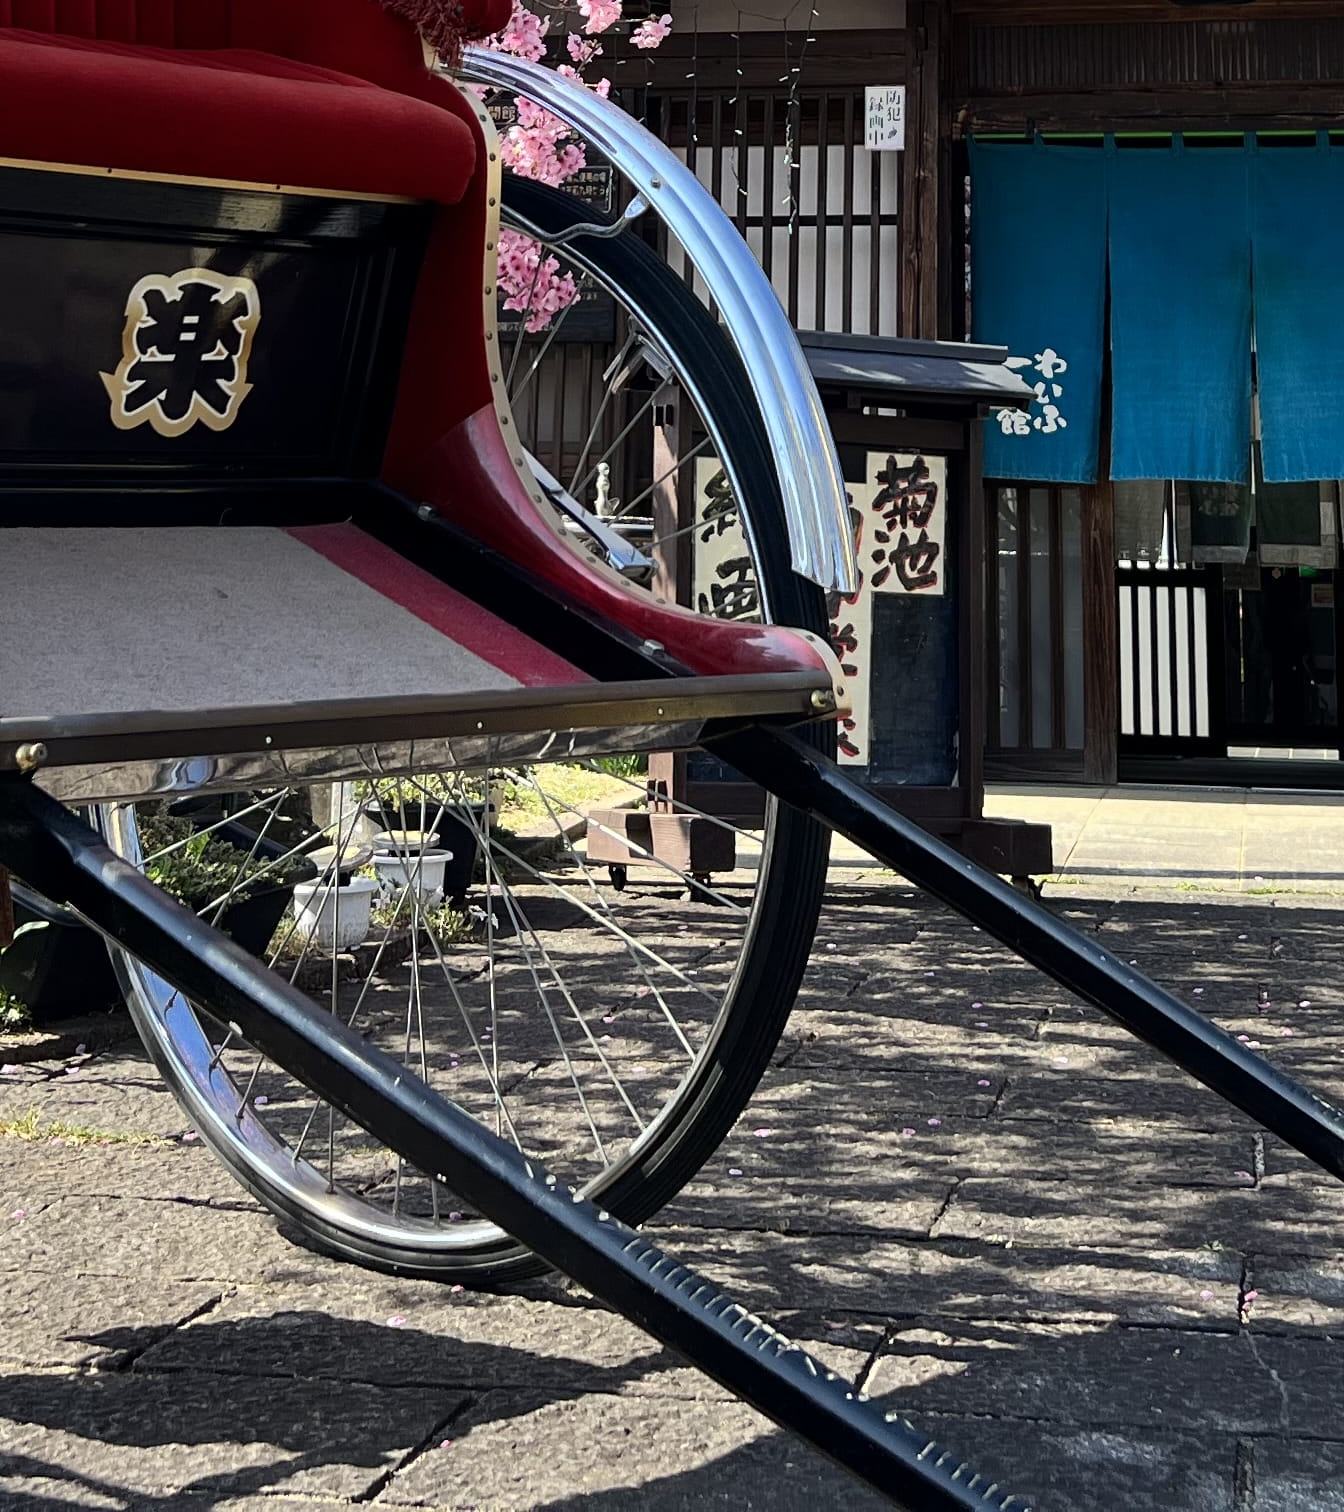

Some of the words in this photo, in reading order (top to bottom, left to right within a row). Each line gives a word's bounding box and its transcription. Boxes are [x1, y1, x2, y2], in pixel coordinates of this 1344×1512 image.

[996, 356, 1033, 436] 一館
[1033, 348, 1068, 434] わいふ
[871, 454, 941, 591] 菊池
